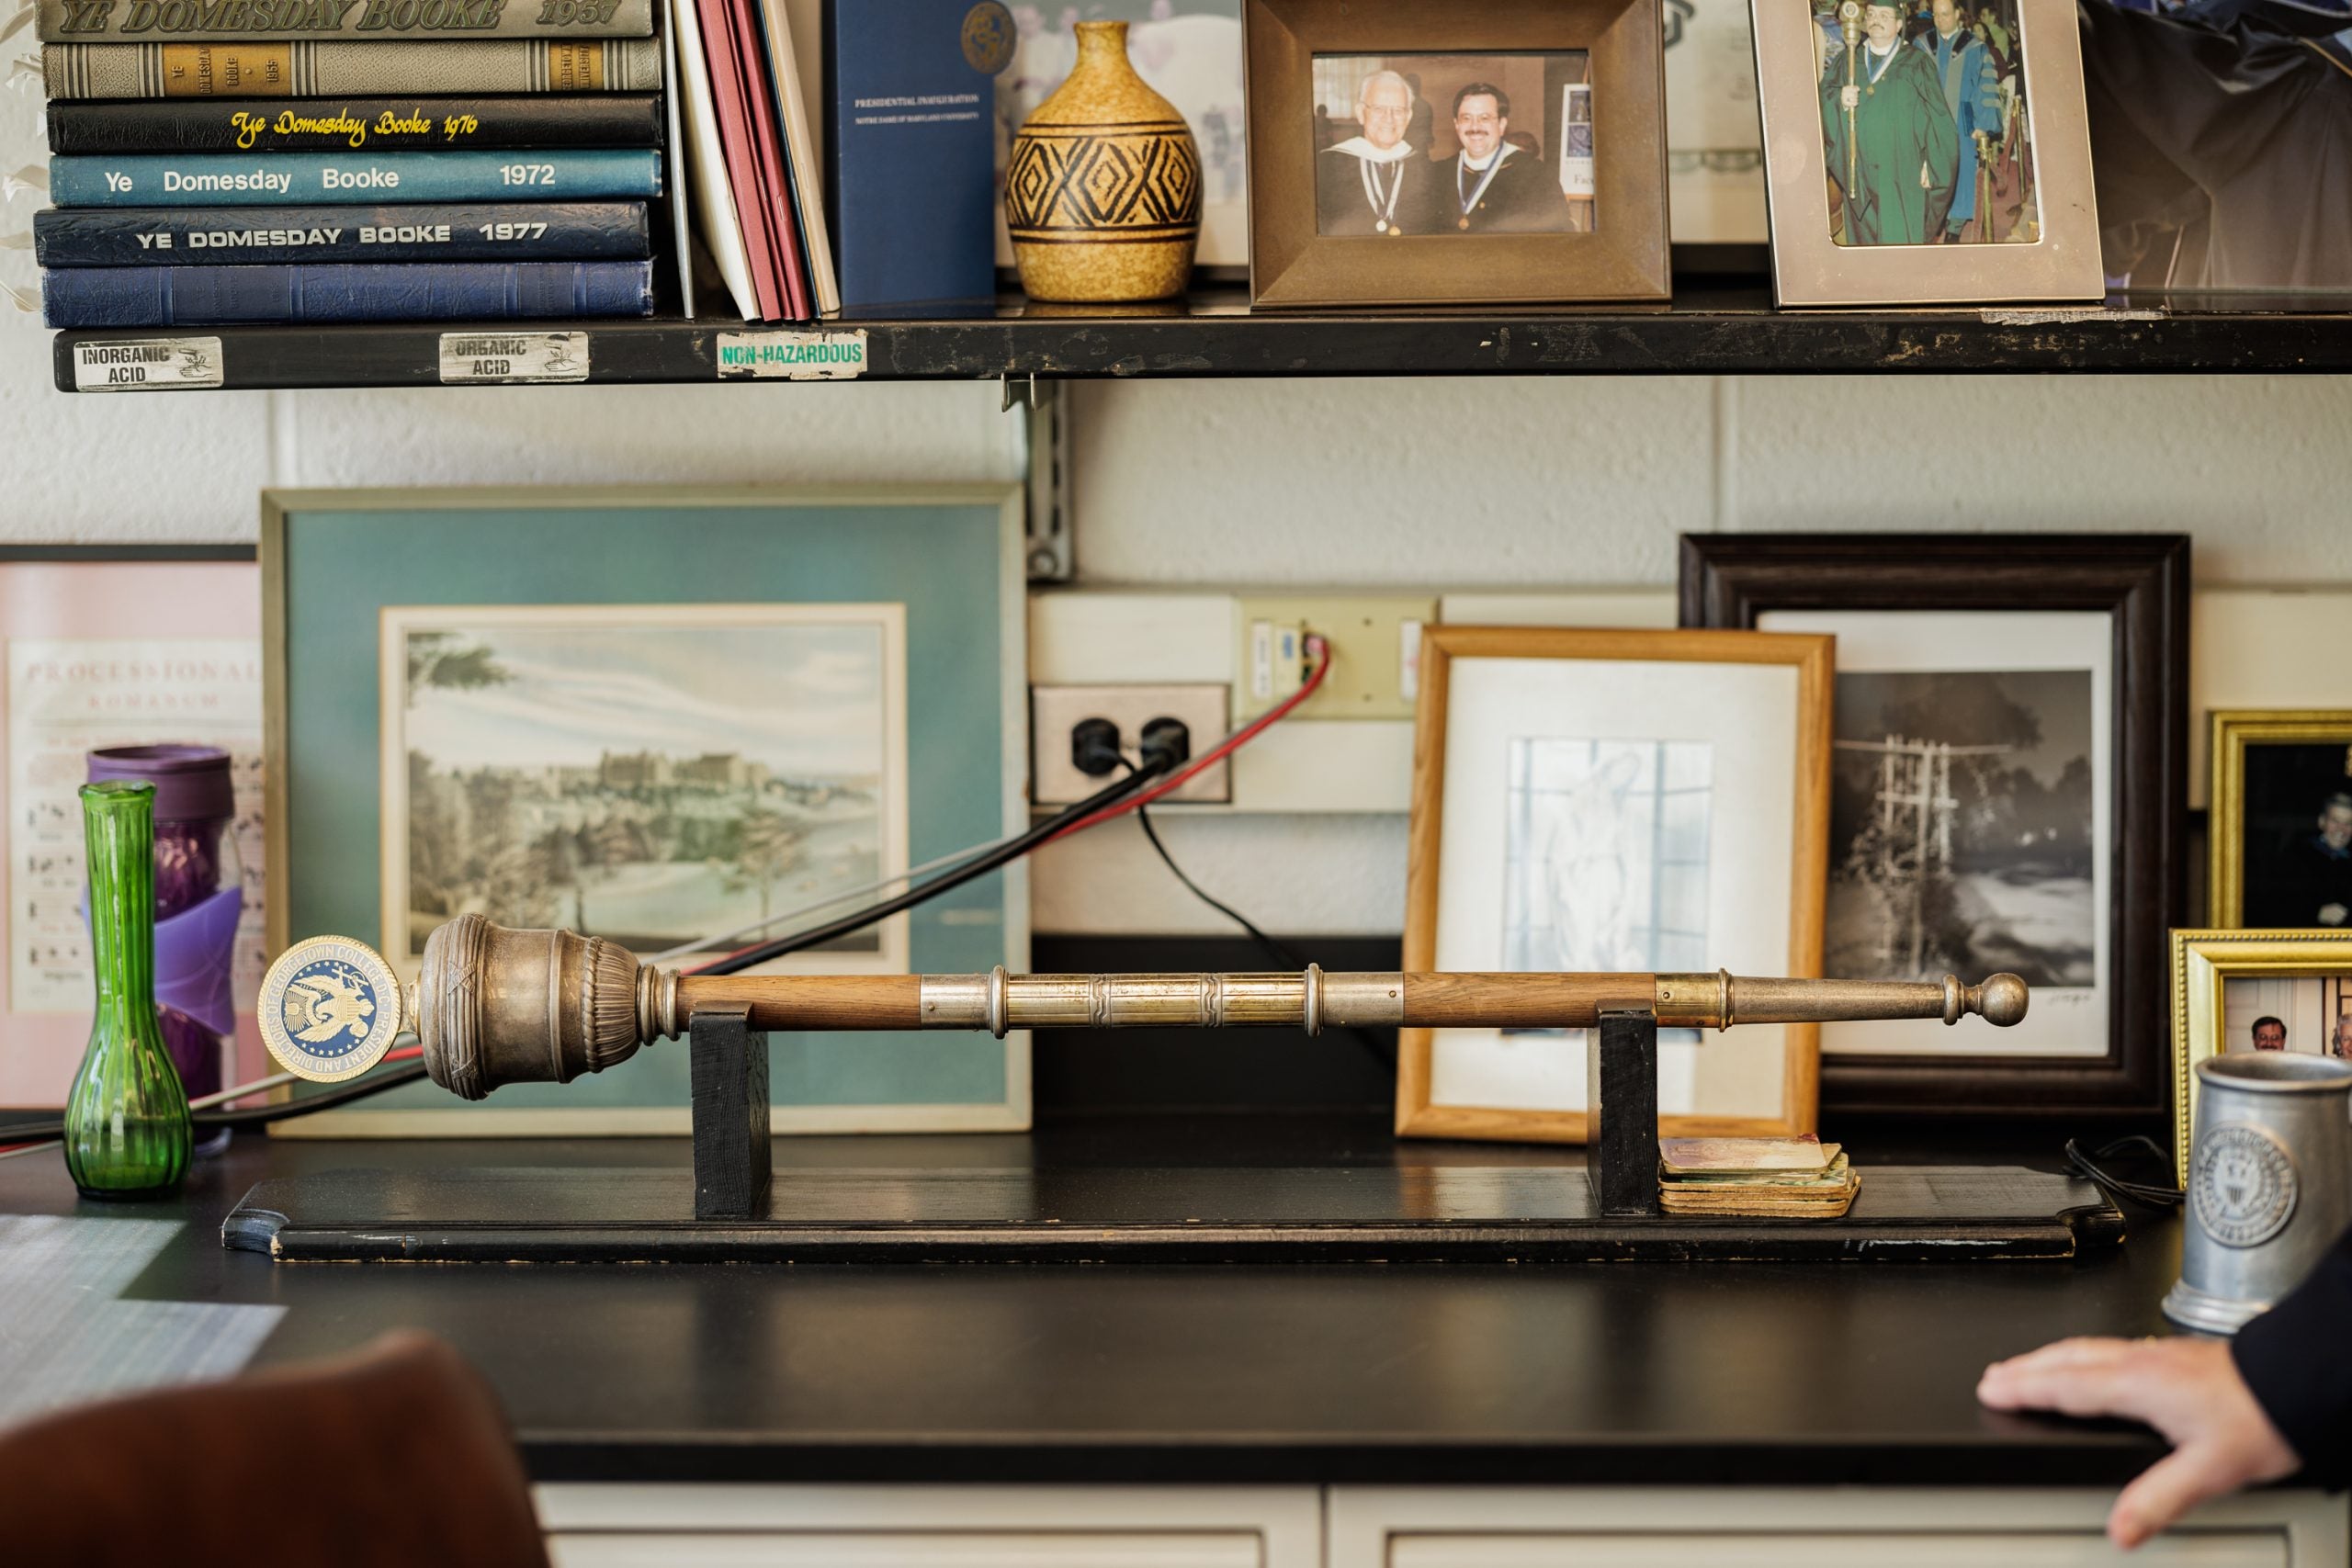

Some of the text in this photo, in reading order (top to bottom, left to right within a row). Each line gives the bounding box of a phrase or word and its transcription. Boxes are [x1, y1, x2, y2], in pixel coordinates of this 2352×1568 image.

[61, 0, 621, 33] YE DOMESDAY BOOKE 1957
[172, 65, 185, 78] YE
[226, 57, 239, 86] BOOKE
[232, 107, 479, 149] Ye Domesday Booke 1976
[105, 164, 556, 194] Ye Domesday Booke 1972
[137, 222, 548, 250] YE DOMESDAY BOOKE 1977
[83, 346, 171, 366] INORGANIC
[455, 340, 526, 356] ORGANIC
[722, 343, 863, 365] NON-HAZARDOUS
[108, 367, 146, 383] ACID
[472, 359, 510, 375] ACID
[269, 945, 335, 998] GEORGETOWN
[337, 945, 384, 986] COLLEGE
[266, 998, 279, 1014] OF
[267, 1017, 313, 1070] DIRECTORS
[345, 1011, 390, 1069] PRESIDENT
[315, 1058, 342, 1073] AND
